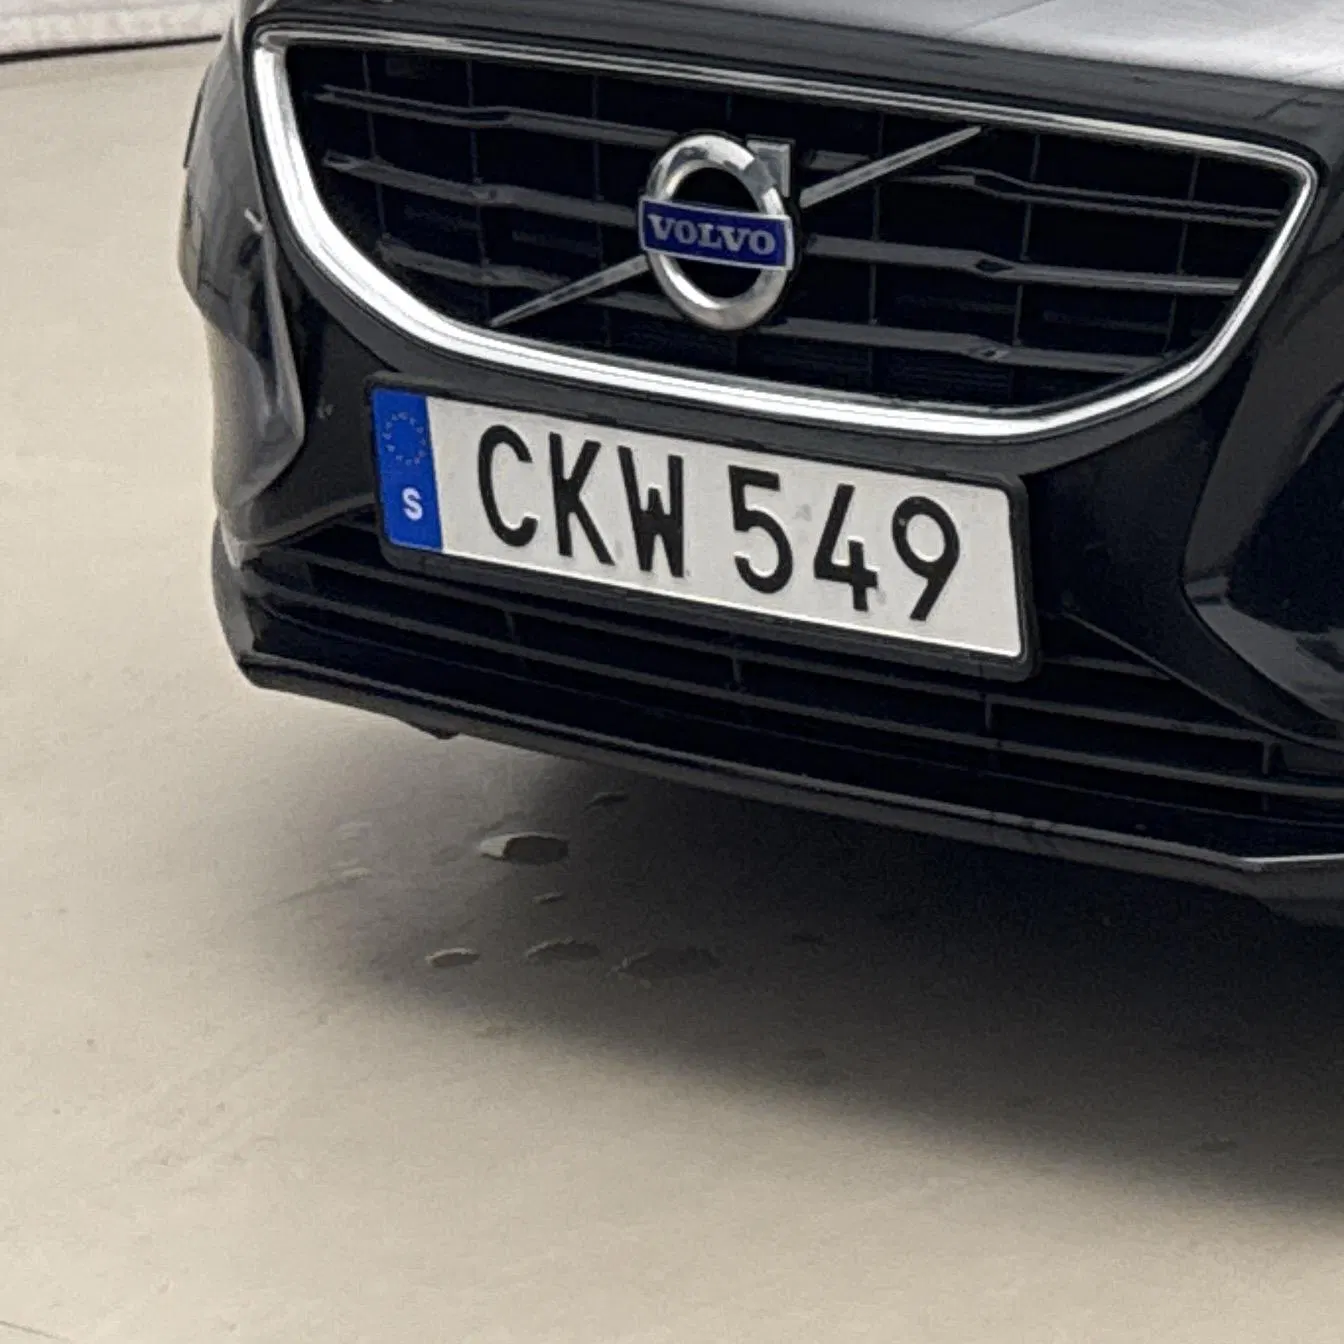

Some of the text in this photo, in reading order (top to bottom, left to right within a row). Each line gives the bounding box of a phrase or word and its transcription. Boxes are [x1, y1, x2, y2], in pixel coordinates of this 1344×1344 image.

[647, 214, 776, 255] VOLVO
[402, 486, 423, 521] S
[478, 425, 961, 621] CKW 549
